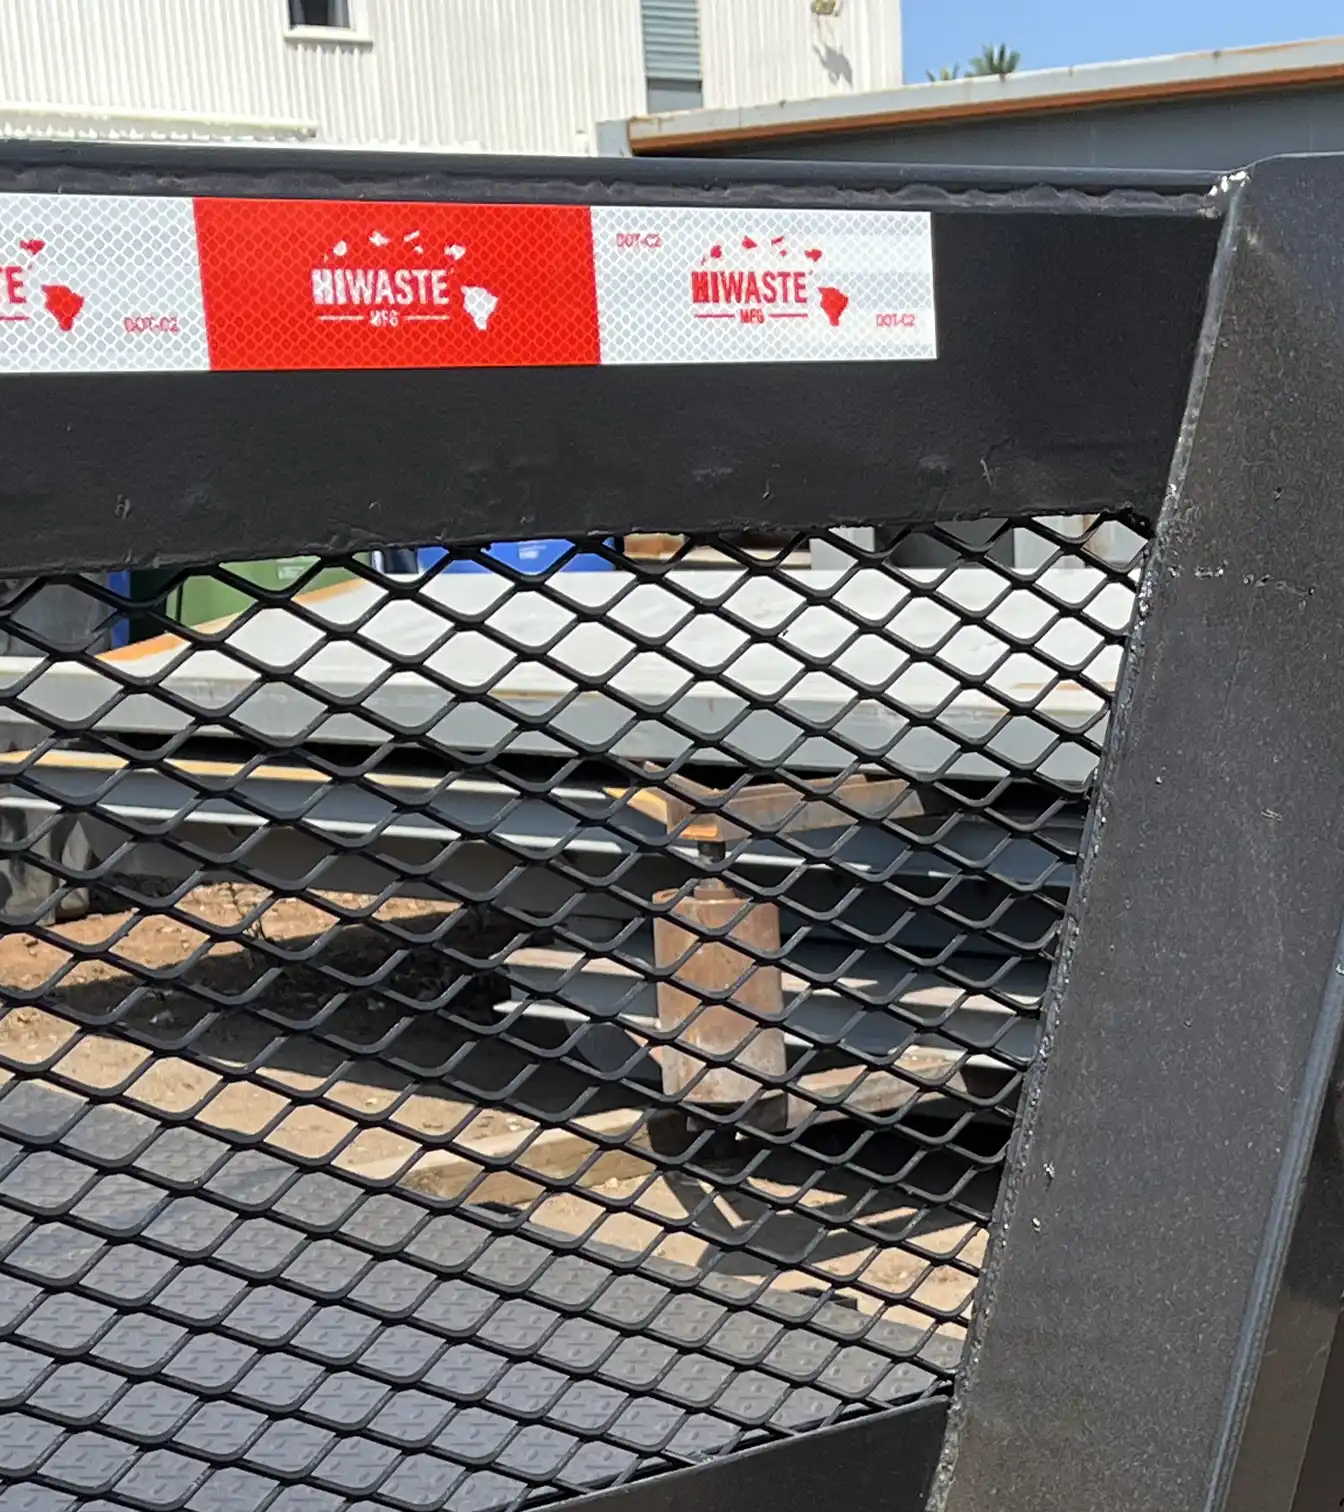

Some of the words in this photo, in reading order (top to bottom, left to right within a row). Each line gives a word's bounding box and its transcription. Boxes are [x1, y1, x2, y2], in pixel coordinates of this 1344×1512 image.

[311, 268, 450, 306] HIWASTE
[690, 271, 808, 304] HIWASTE
[739, 308, 765, 325] MFG
